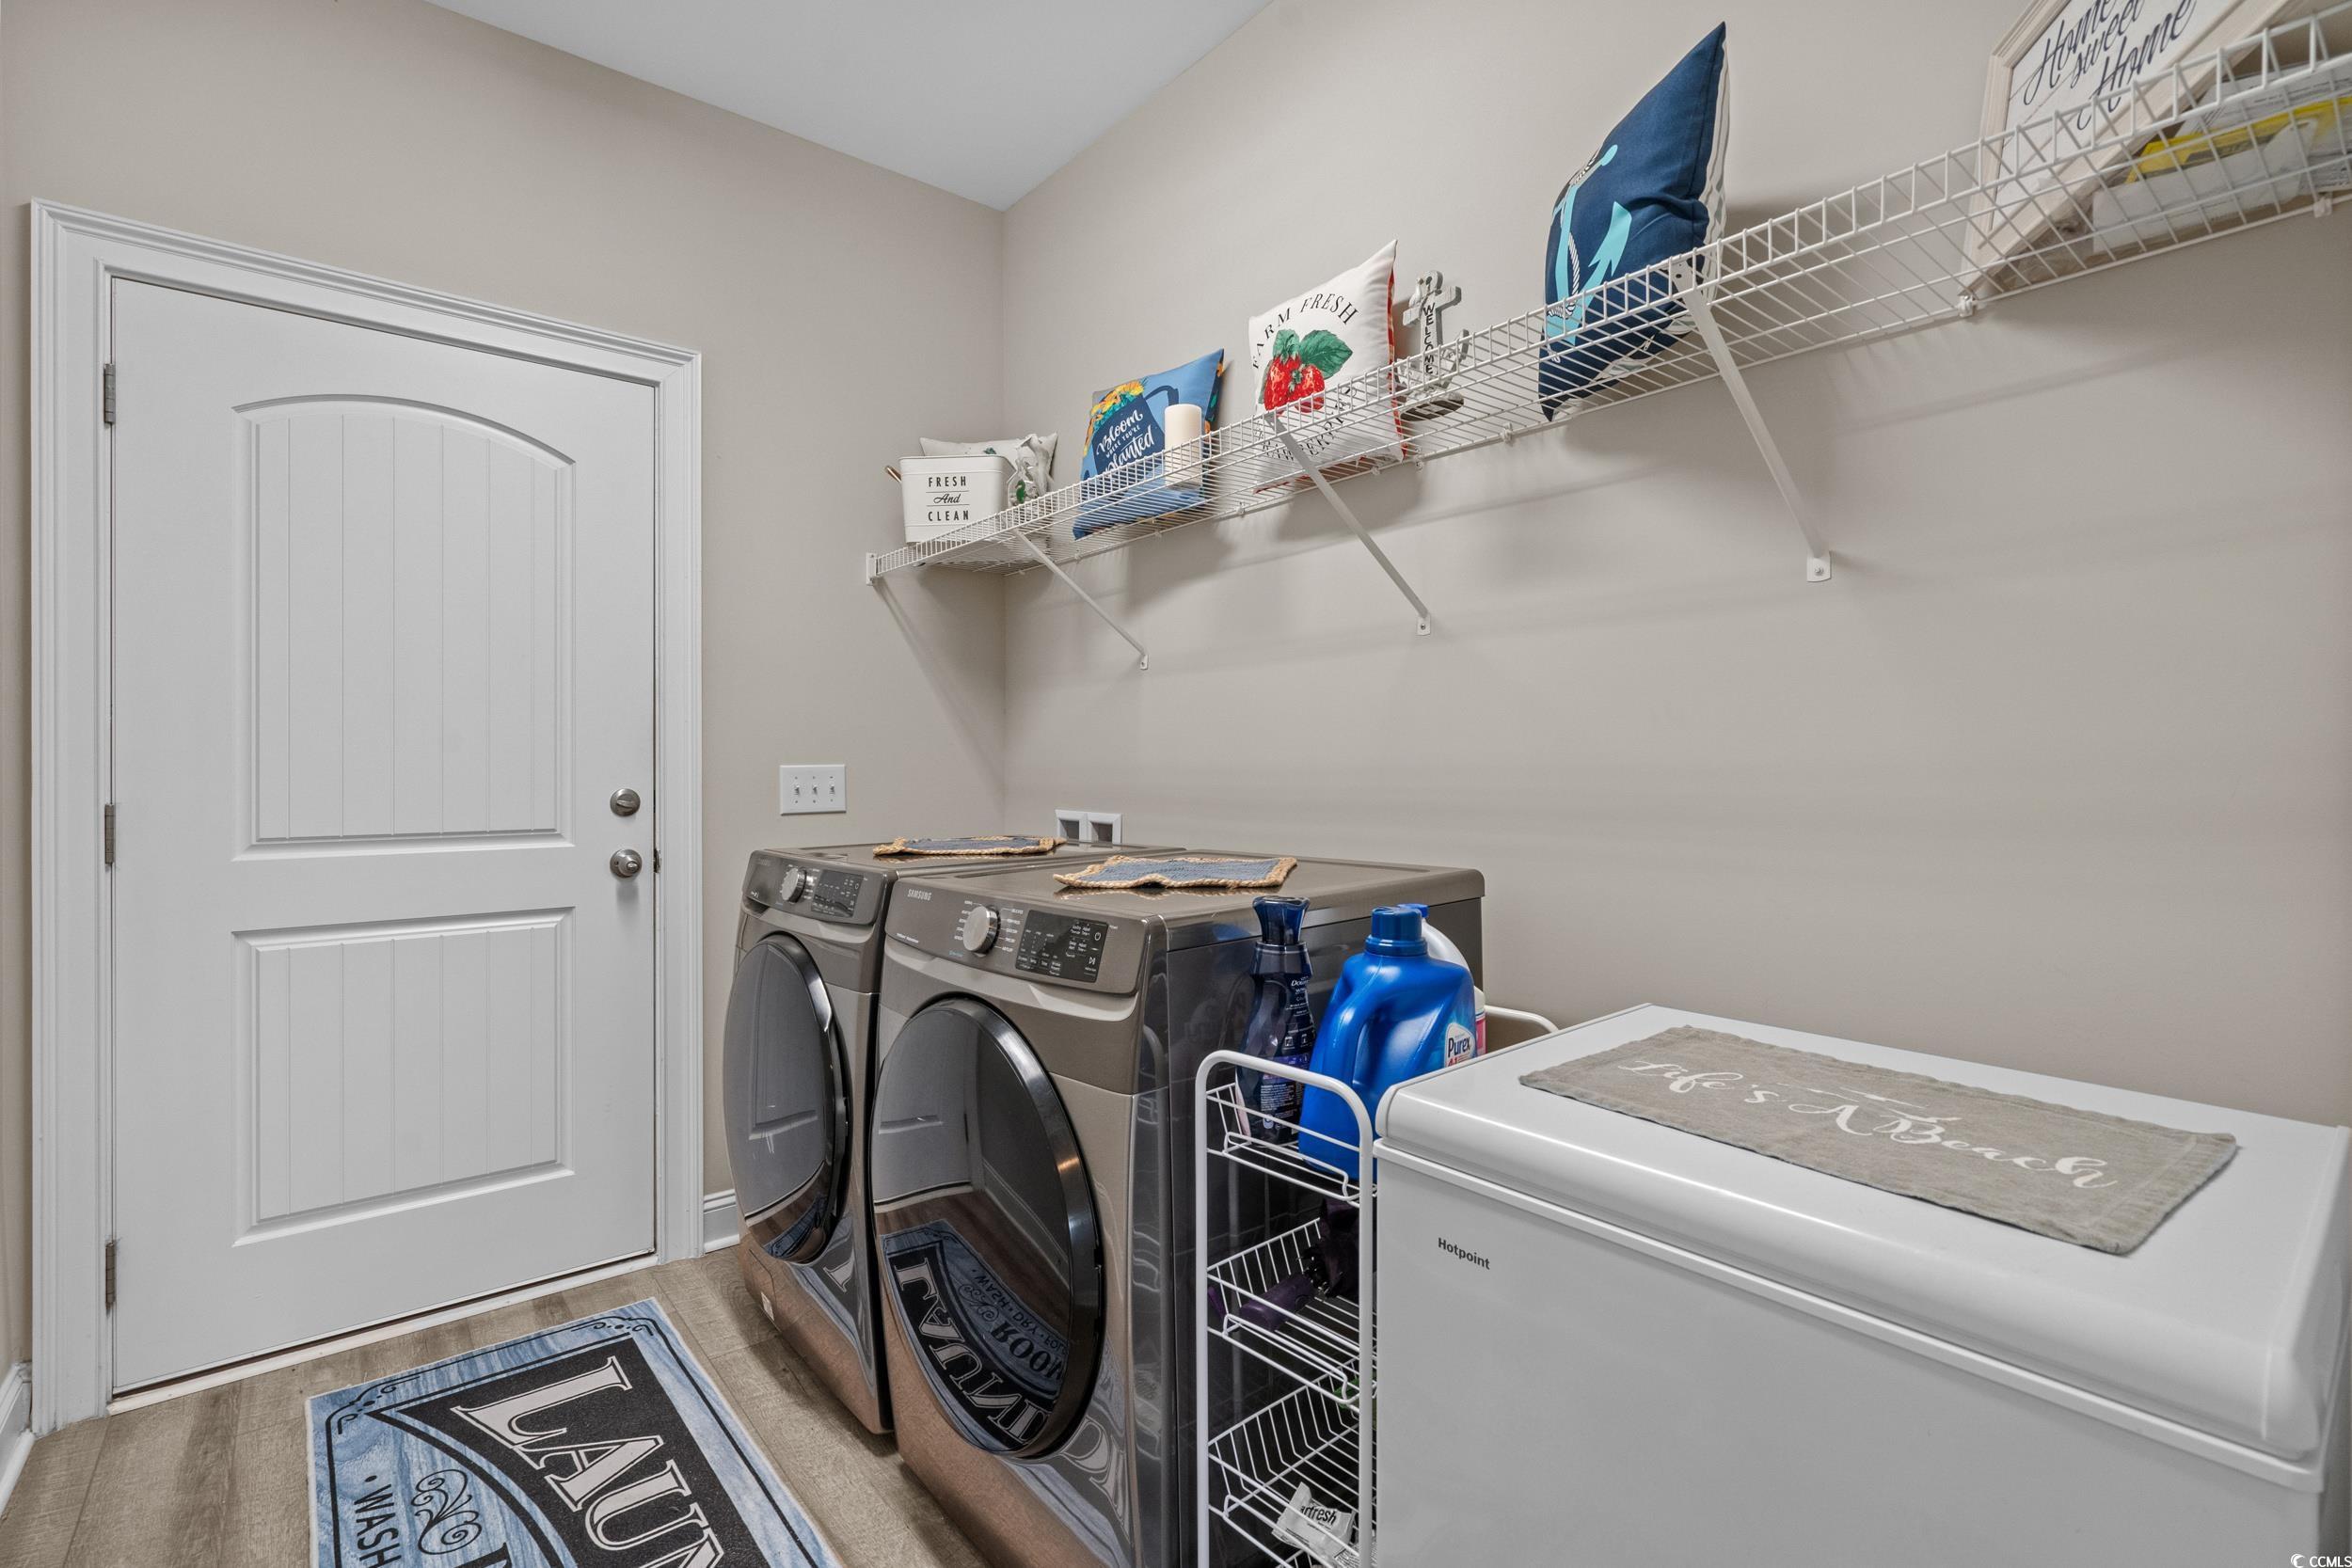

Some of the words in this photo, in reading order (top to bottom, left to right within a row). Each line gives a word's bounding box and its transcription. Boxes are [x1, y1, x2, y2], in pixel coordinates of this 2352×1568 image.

[2076, 0, 2198, 130] Home
[1252, 308, 1292, 370] FARM
[1300, 293, 1359, 325] FRESH
[1096, 409, 1143, 455] Bloom
[1106, 440, 1121, 458] WHERE
[928, 476, 967, 487] FRESH
[933, 493, 961, 504] And
[928, 510, 969, 521] CLEAN
[907, 888, 932, 901] SAMSUNG
[1447, 1037, 1470, 1058] Purex
[1438, 1237, 1490, 1270] Hotpoint
[354, 1483, 402, 1568] WASH
